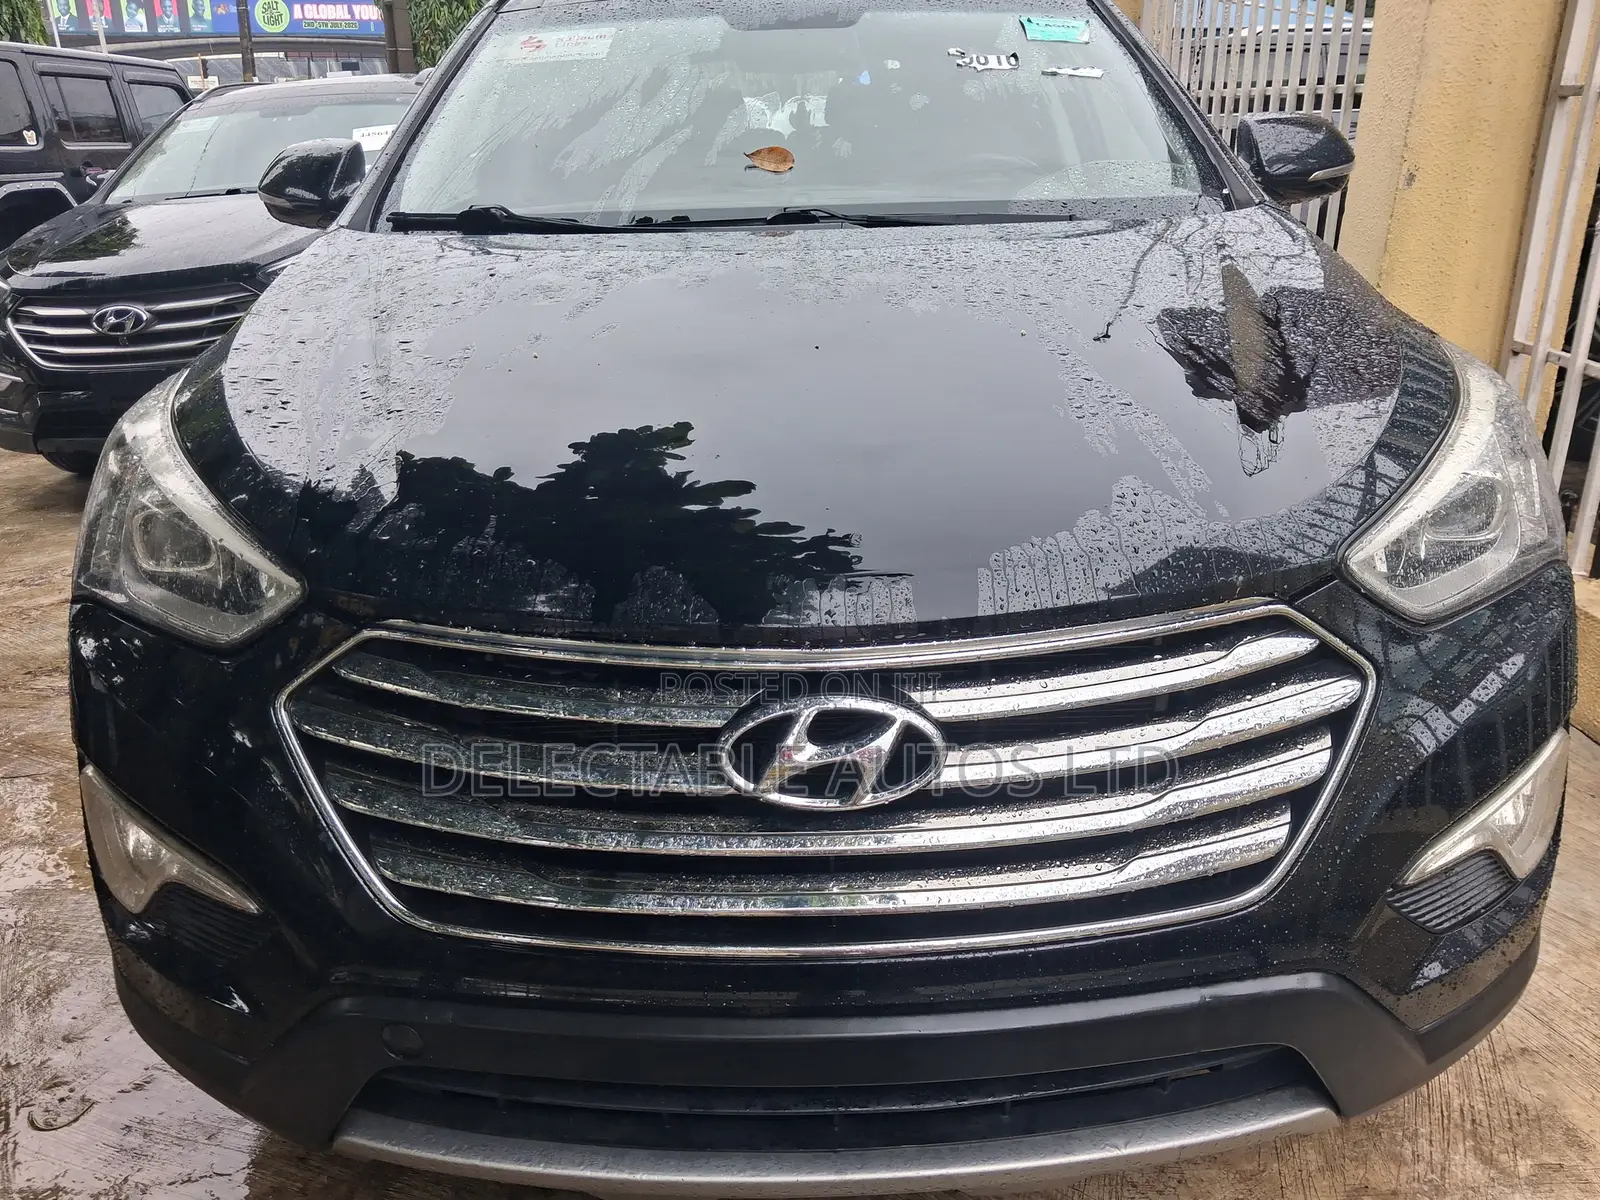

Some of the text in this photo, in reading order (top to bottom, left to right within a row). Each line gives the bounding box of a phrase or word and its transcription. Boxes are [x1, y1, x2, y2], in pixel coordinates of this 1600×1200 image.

[261, 0, 279, 14] SALT
[293, 4, 303, 20] A
[303, 4, 352, 20] GLOBAL
[262, 13, 284, 26] LIGHT
